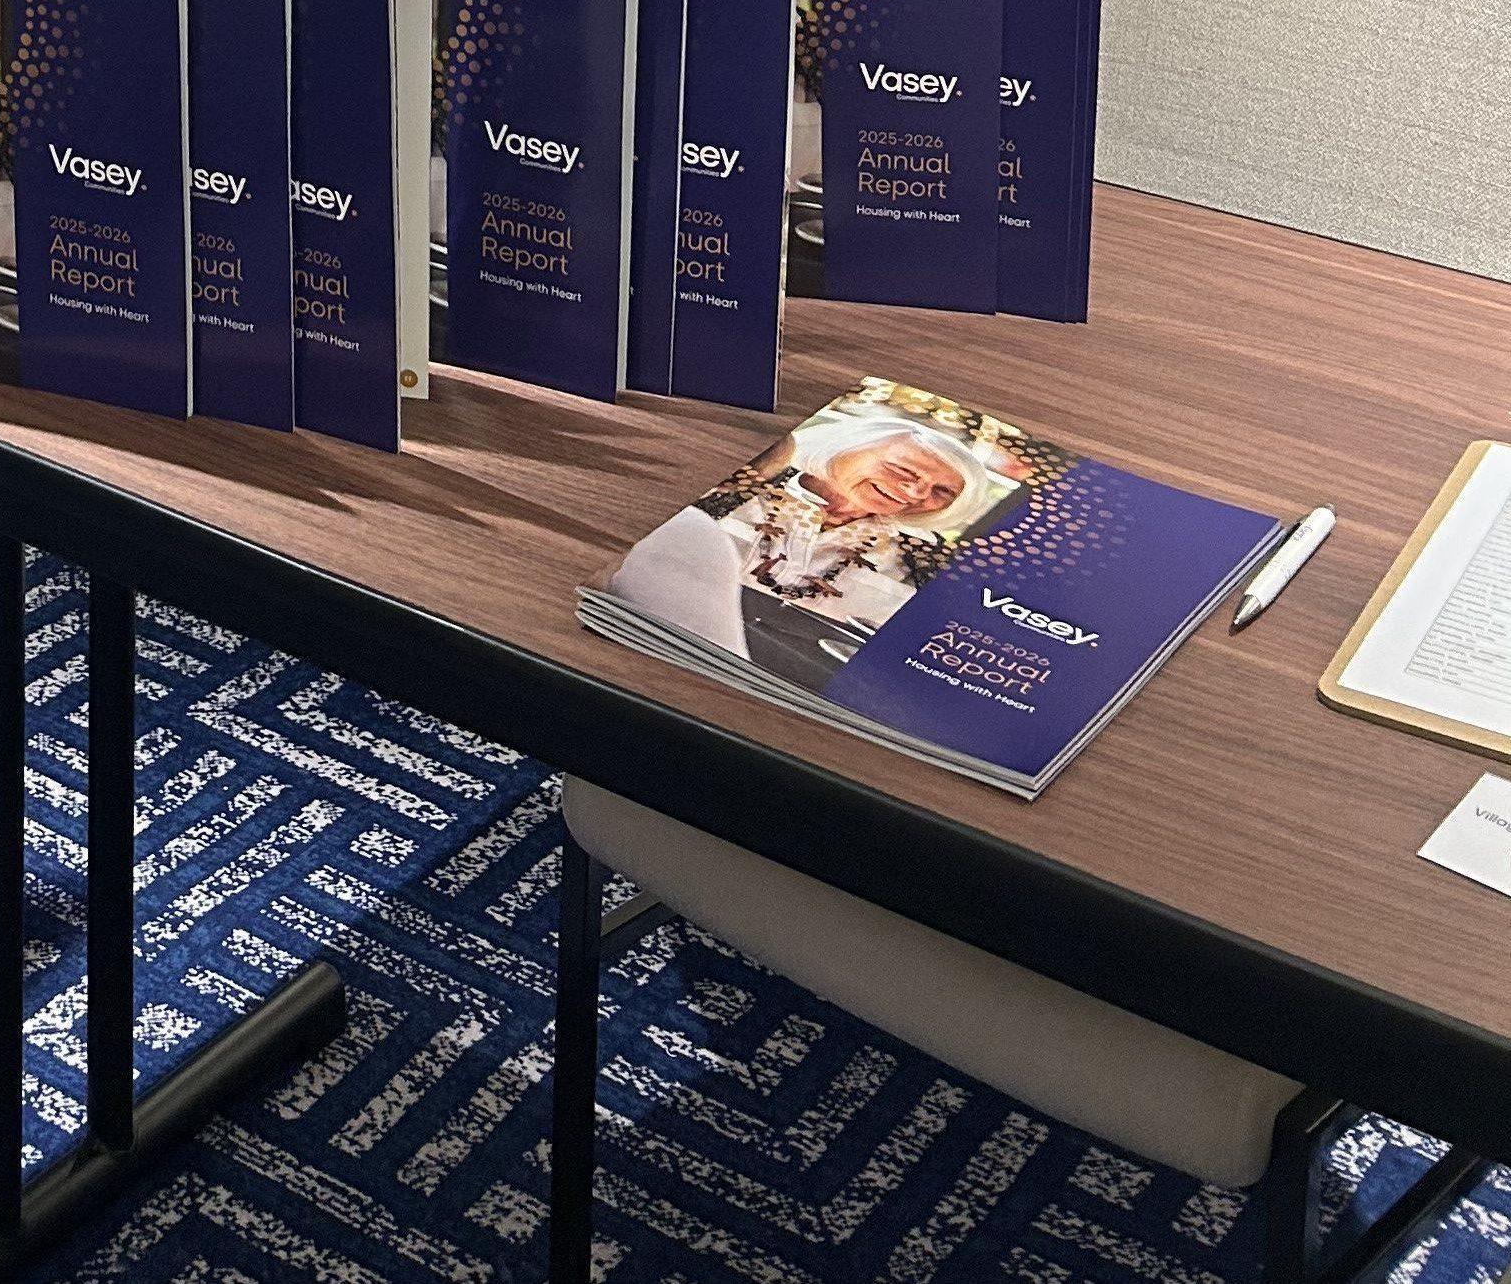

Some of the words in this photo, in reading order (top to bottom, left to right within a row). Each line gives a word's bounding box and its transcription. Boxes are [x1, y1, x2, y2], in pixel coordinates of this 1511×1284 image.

[858, 130, 944, 149] 2025-2026
[682, 142, 745, 178] sey.
[858, 147, 951, 174] Annual
[858, 171, 947, 201] Report
[483, 192, 566, 222] 2025-2026
[856, 204, 901, 220] Housing
[903, 210, 927, 219] with
[929, 210, 960, 223] Heart
[49, 215, 131, 243] 2025-2026
[482, 210, 573, 250] Annual
[49, 234, 139, 272] Annual
[482, 236, 568, 276] Report
[51, 259, 136, 299] Report
[295, 269, 350, 300] nual
[480, 270, 523, 291] Housing
[525, 282, 549, 295] with
[551, 286, 583, 303] Heart
[49, 293, 93, 313] Housing
[94, 304, 117, 316] with
[119, 308, 150, 323] Heart
[294, 295, 346, 324] port
[706, 294, 739, 309] Heart
[223, 317, 255, 333] Heart
[330, 333, 361, 352] Heart
[930, 632, 1053, 684] Annual
[945, 620, 1051, 667] 2025-2026
[920, 641, 1034, 695] Report
[904, 657, 961, 686] Housing
[963, 681, 993, 698] with
[994, 693, 1036, 714] Heart
